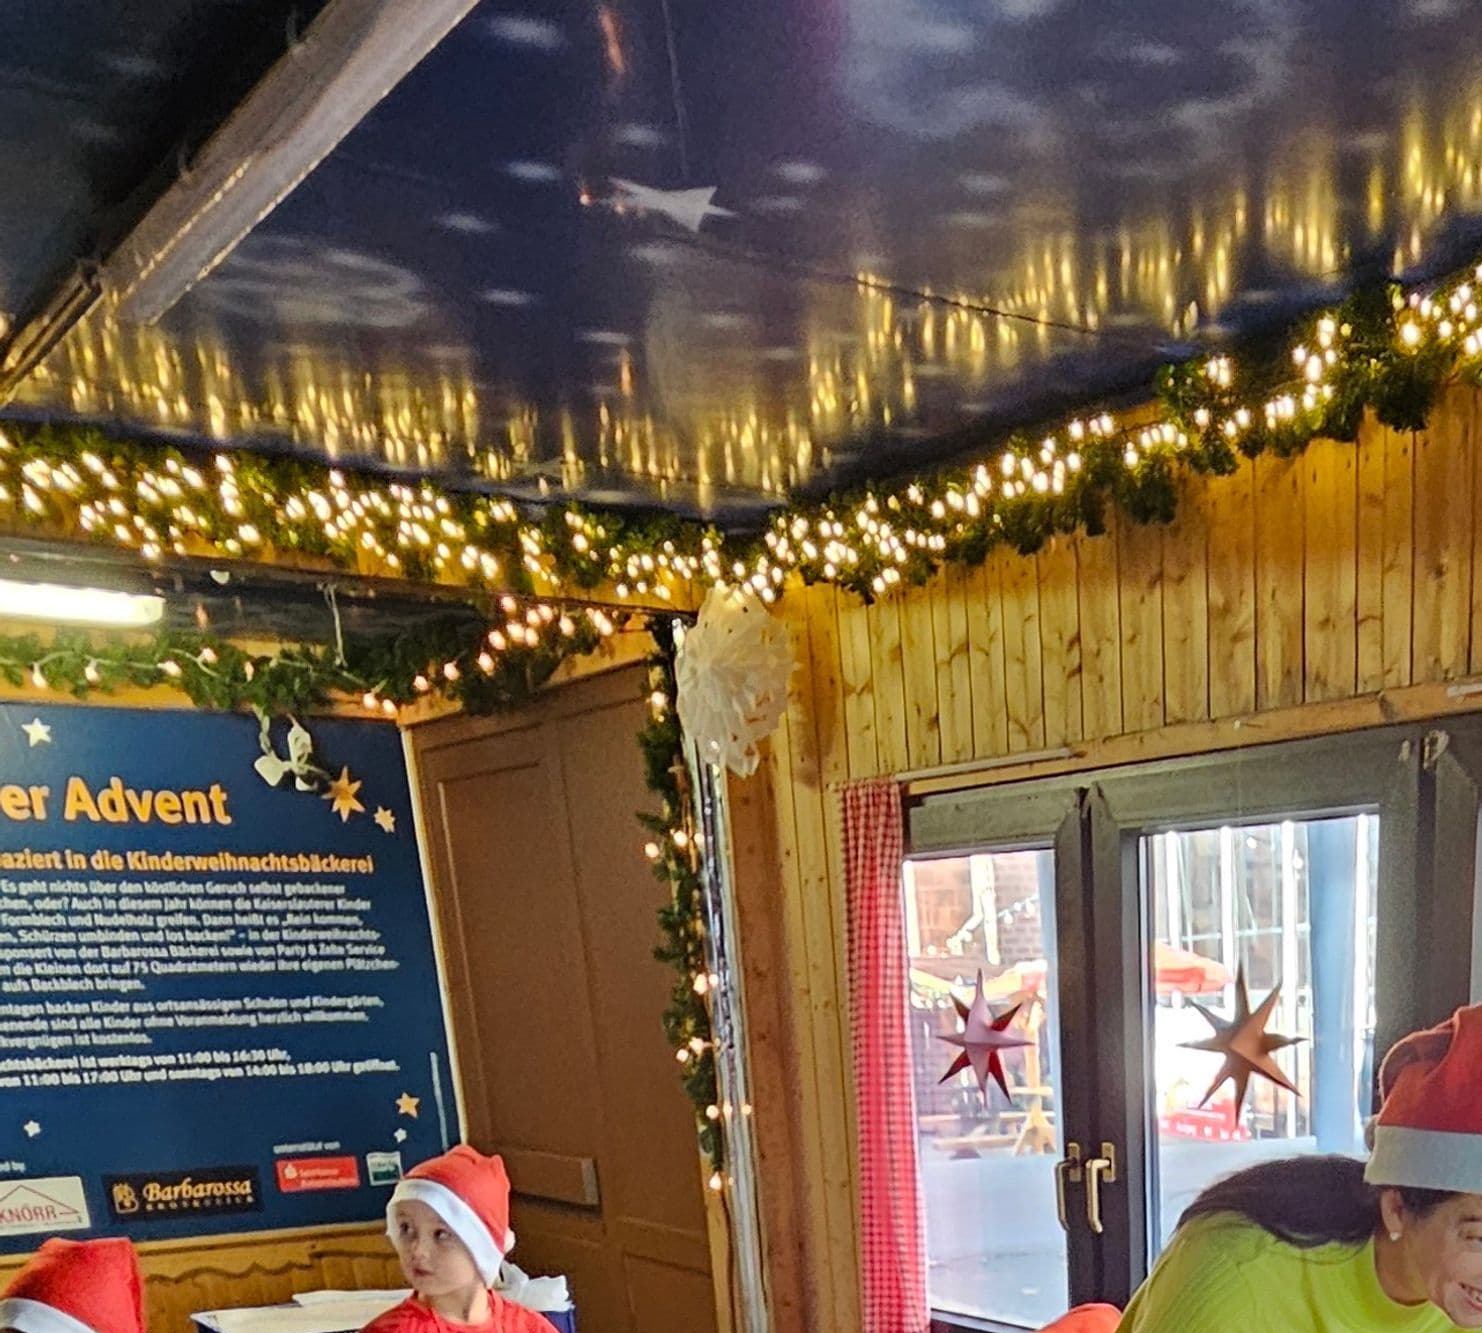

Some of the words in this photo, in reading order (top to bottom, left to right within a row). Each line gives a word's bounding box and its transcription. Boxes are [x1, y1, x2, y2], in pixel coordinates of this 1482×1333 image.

[0, 784, 50, 822] er
[63, 776, 233, 826] Advent
[0, 848, 64, 871] aziert
[65, 849, 87, 870] in
[90, 850, 125, 870] die
[127, 851, 375, 873] Kinderweihnachtsbäckerei
[143, 1176, 252, 1202] Barbarossa
